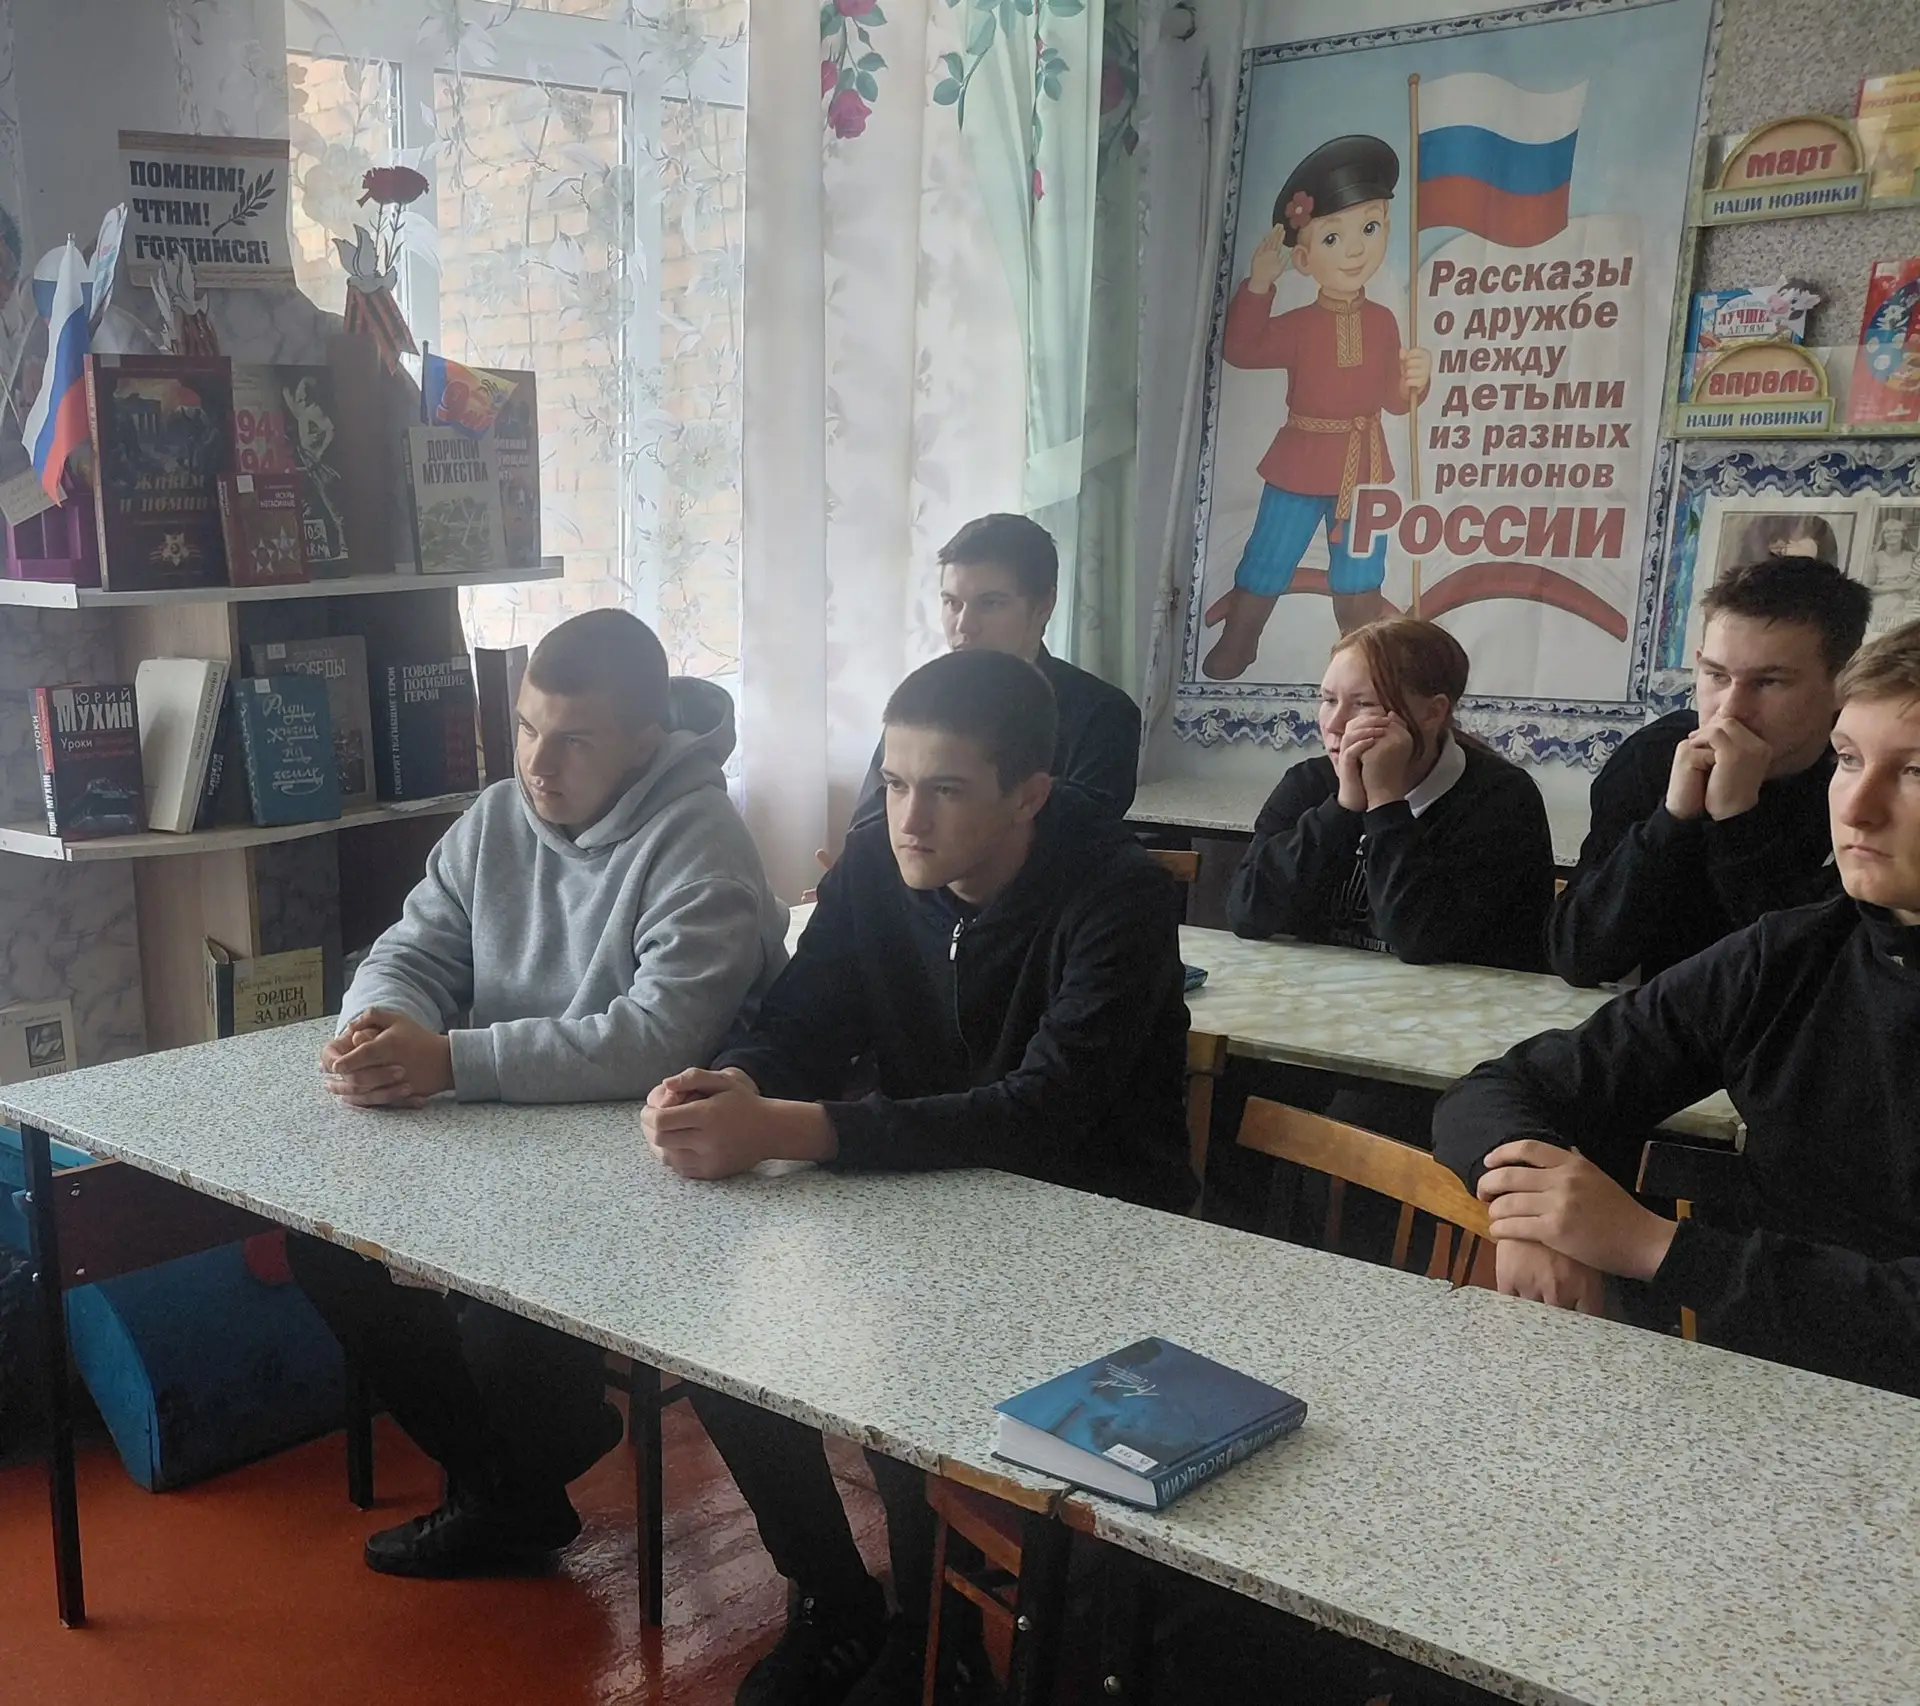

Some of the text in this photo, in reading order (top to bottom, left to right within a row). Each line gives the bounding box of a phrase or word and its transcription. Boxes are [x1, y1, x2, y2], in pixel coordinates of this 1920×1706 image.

[1746, 144, 1837, 178] март
[130, 160, 245, 193] ПОМНИМ!
[132, 198, 210, 227] ЧТИМ!
[1713, 186, 1858, 215] НАШИ НОВИНКИ
[135, 234, 270, 265] ГОРДИМСЯ!
[1429, 257, 1633, 297] Рассказы
[1433, 291, 1618, 340] о дружбе
[1438, 345, 1566, 378] между
[1708, 369, 1815, 398] апрель
[1441, 380, 1625, 418] детьми
[1686, 410, 1823, 428] НАШИ НОВИНКИ
[1429, 423, 1632, 455] из разных
[422, 461, 488, 486] МУЖЕСТВА
[1435, 462, 1614, 494] регионов
[403, 663, 451, 678] ГОВОРЯТ
[403, 674, 465, 690] ПОГИБШИЕ
[75, 688, 132, 704] ЮРИЙ
[404, 688, 439, 703] ГЕРОИ
[33, 715, 43, 750] УРОКИ
[60, 737, 93, 751] Уроки
[43, 774, 55, 809] МУХИН
[257, 986, 304, 1006] ОРДЕН
[255, 1000, 308, 1024] ЗА БОЙ
